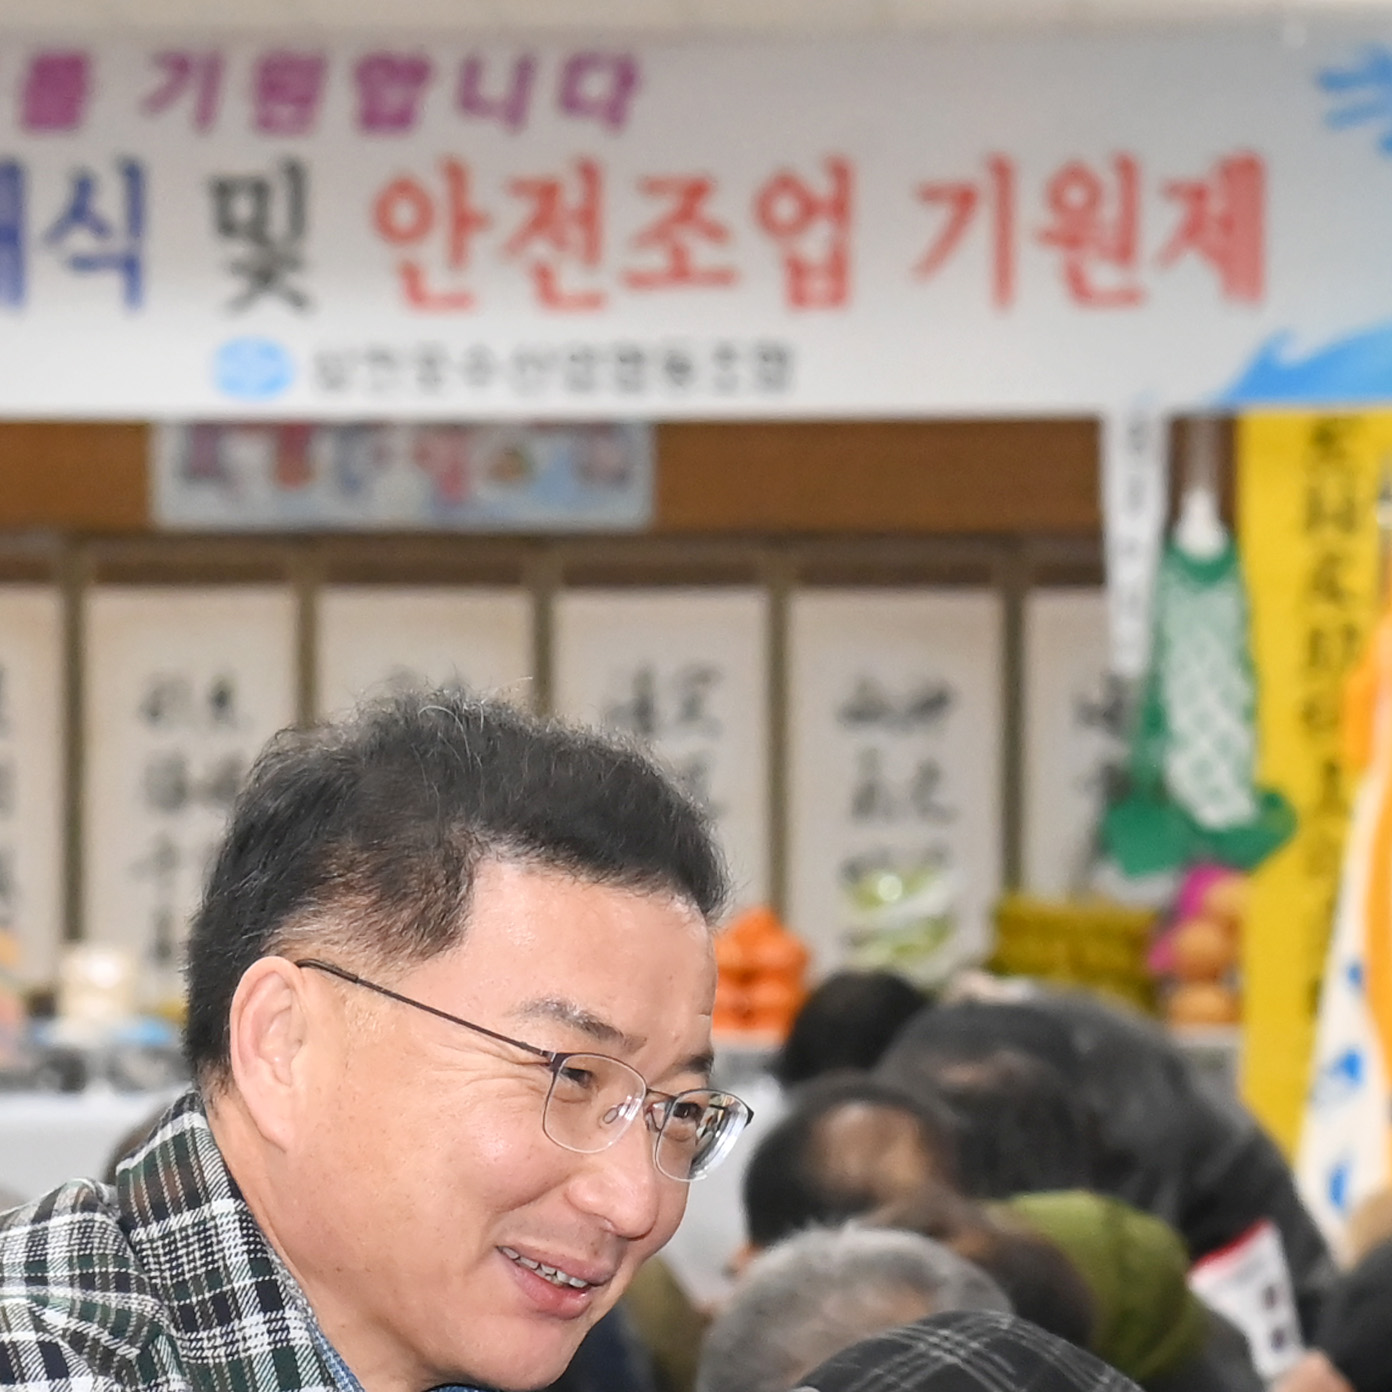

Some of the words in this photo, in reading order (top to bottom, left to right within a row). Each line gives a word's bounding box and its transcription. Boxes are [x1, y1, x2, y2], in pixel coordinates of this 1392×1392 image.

[143, 48, 642, 137] 기원합니다
[208, 155, 311, 312] 및
[370, 155, 855, 313] 안전조업
[914, 150, 1267, 311] 기원제
